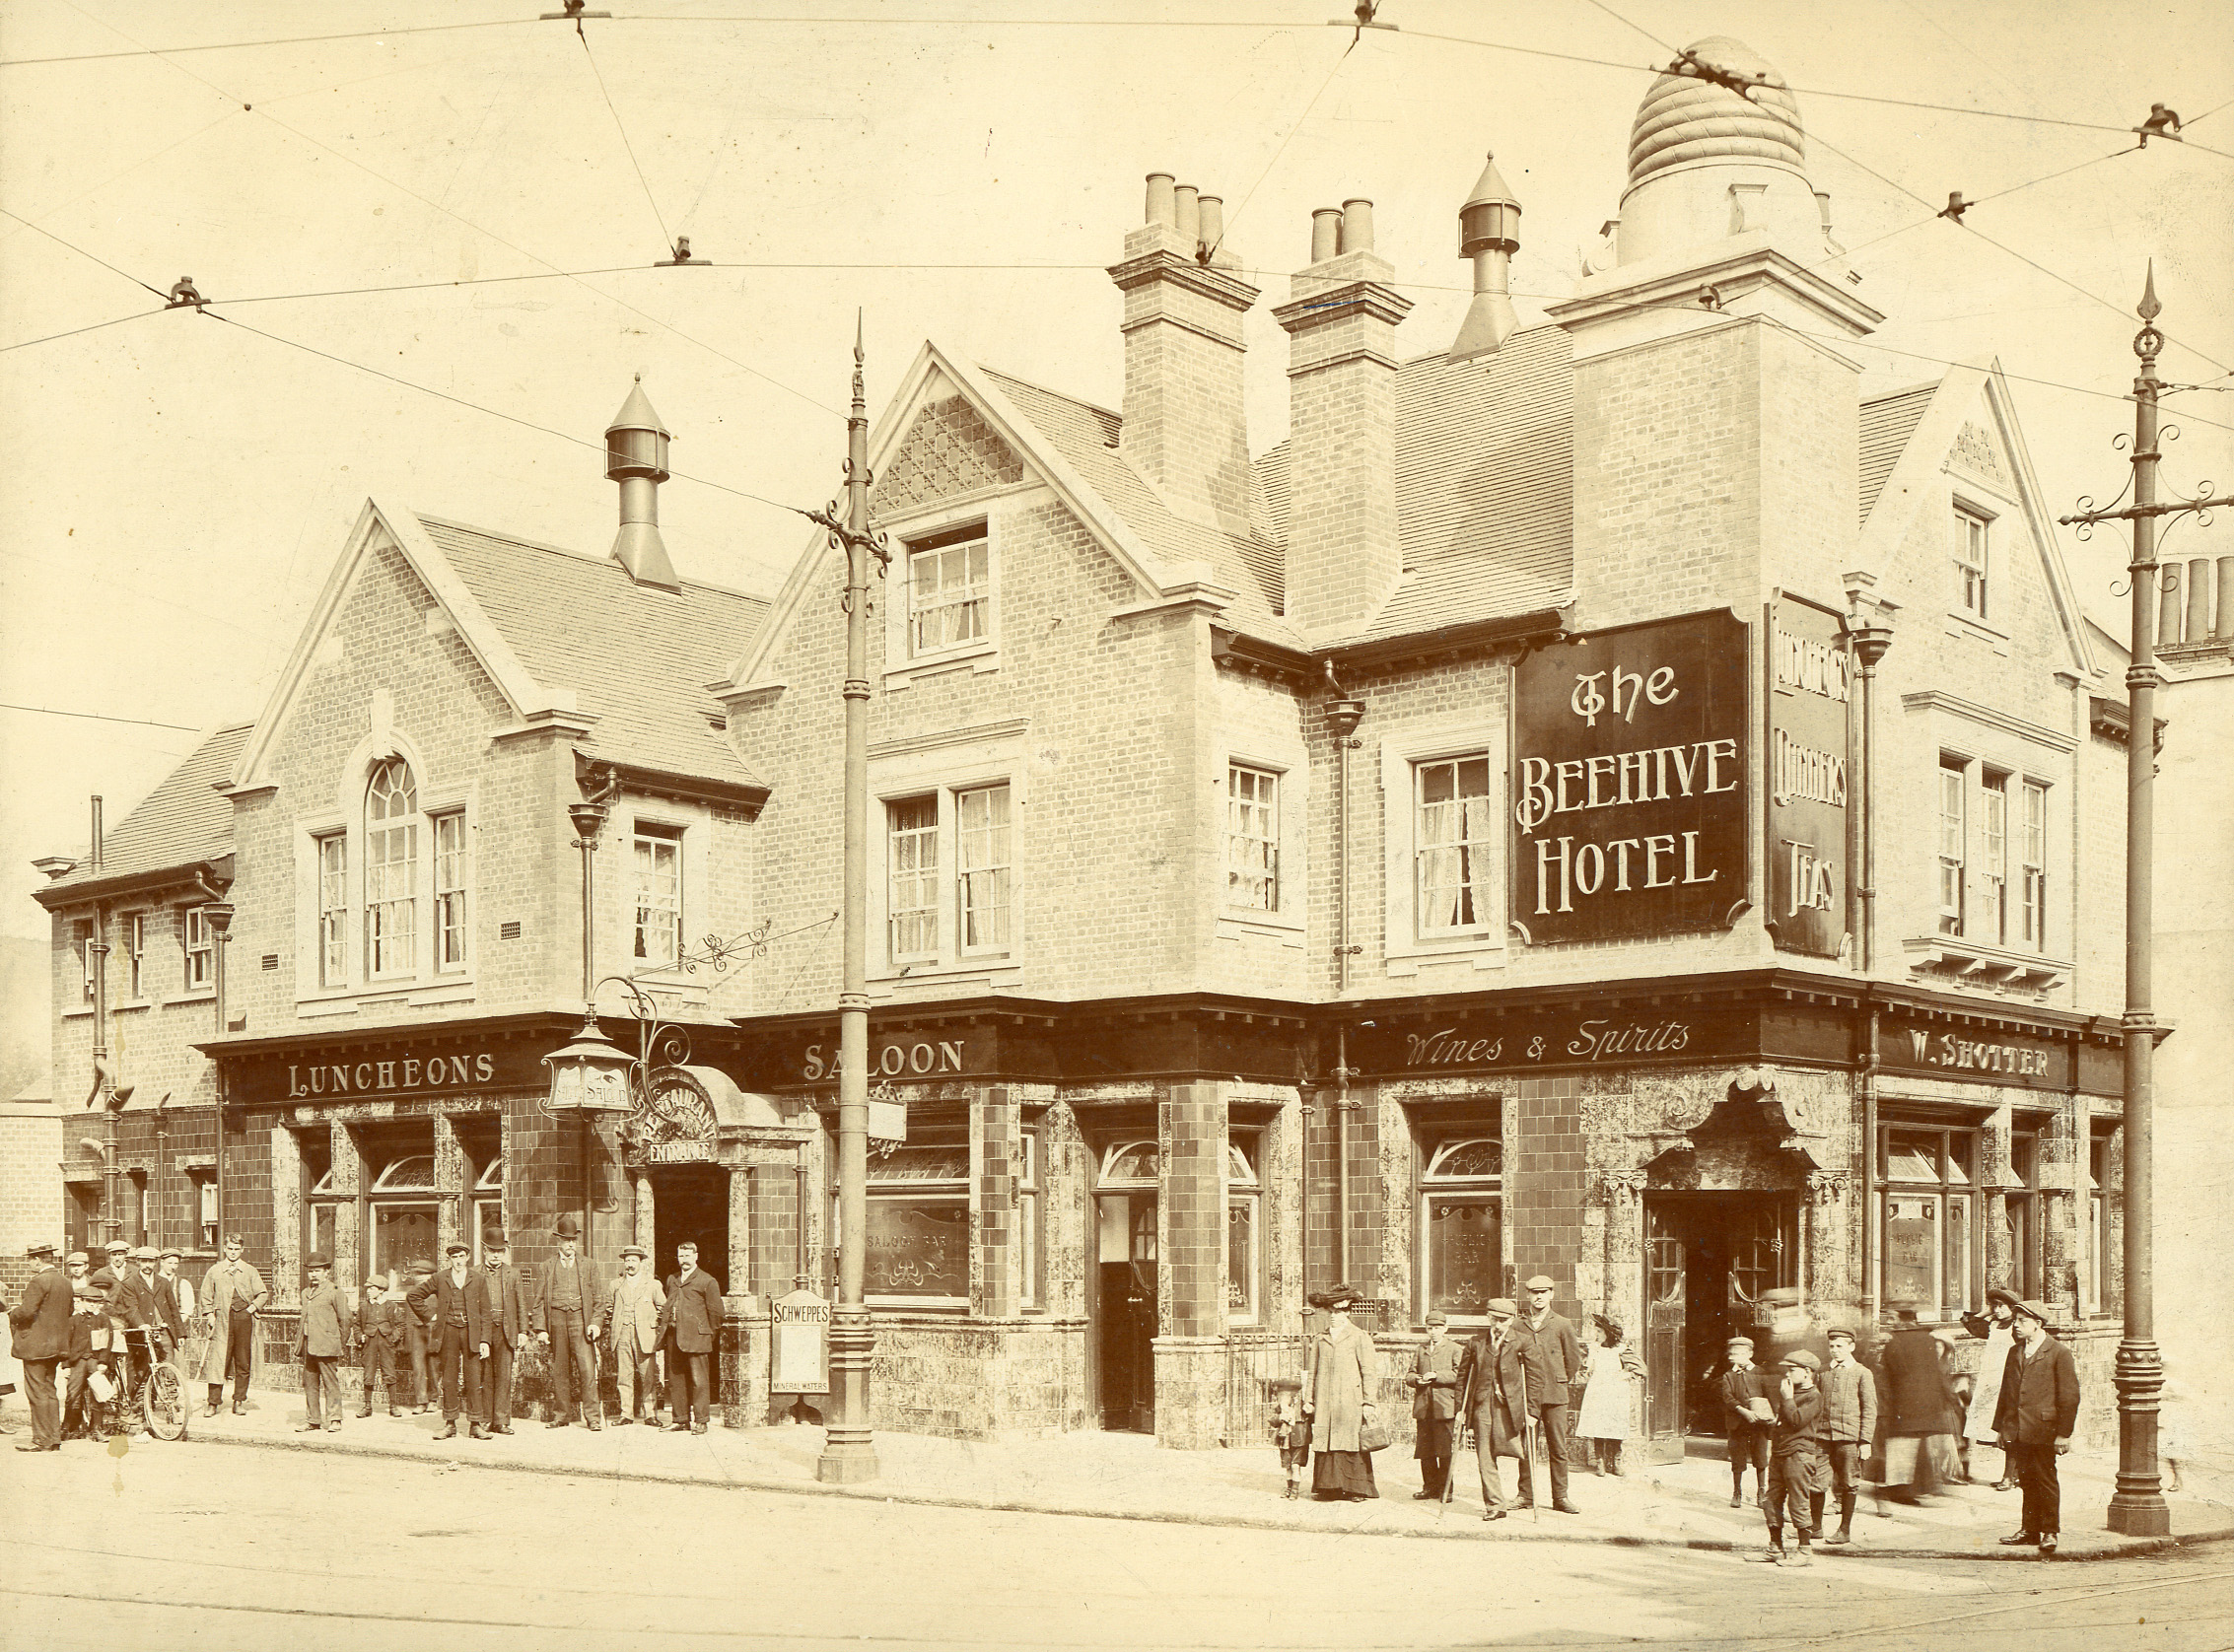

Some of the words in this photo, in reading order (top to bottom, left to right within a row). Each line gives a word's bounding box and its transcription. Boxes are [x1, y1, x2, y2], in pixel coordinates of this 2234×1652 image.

[1571, 664, 1679, 727] The
[1515, 738, 1738, 835] BEEHIVE
[1773, 726, 1848, 808] DINNERS
[1534, 830, 1718, 915] HOTEL
[1780, 838, 1835, 918] TEAS
[803, 1041, 965, 1080] SAOON
[1407, 1027, 1503, 1066] Wines
[1526, 1036, 1547, 1061] &
[1567, 1019, 1690, 1061] Spirits
[1909, 1029, 1937, 1065] W.
[1940, 1033, 2049, 1076] SHOTTER
[288, 1053, 495, 1097] LUNCHEONS
[587, 1083, 626, 1102] SALON
[650, 1142, 710, 1162] ENTRANCE
[774, 1303, 829, 1323] SCHWEPPES
[773, 1382, 801, 1391] MINERAL
[802, 1382, 828, 1391] WATERS
